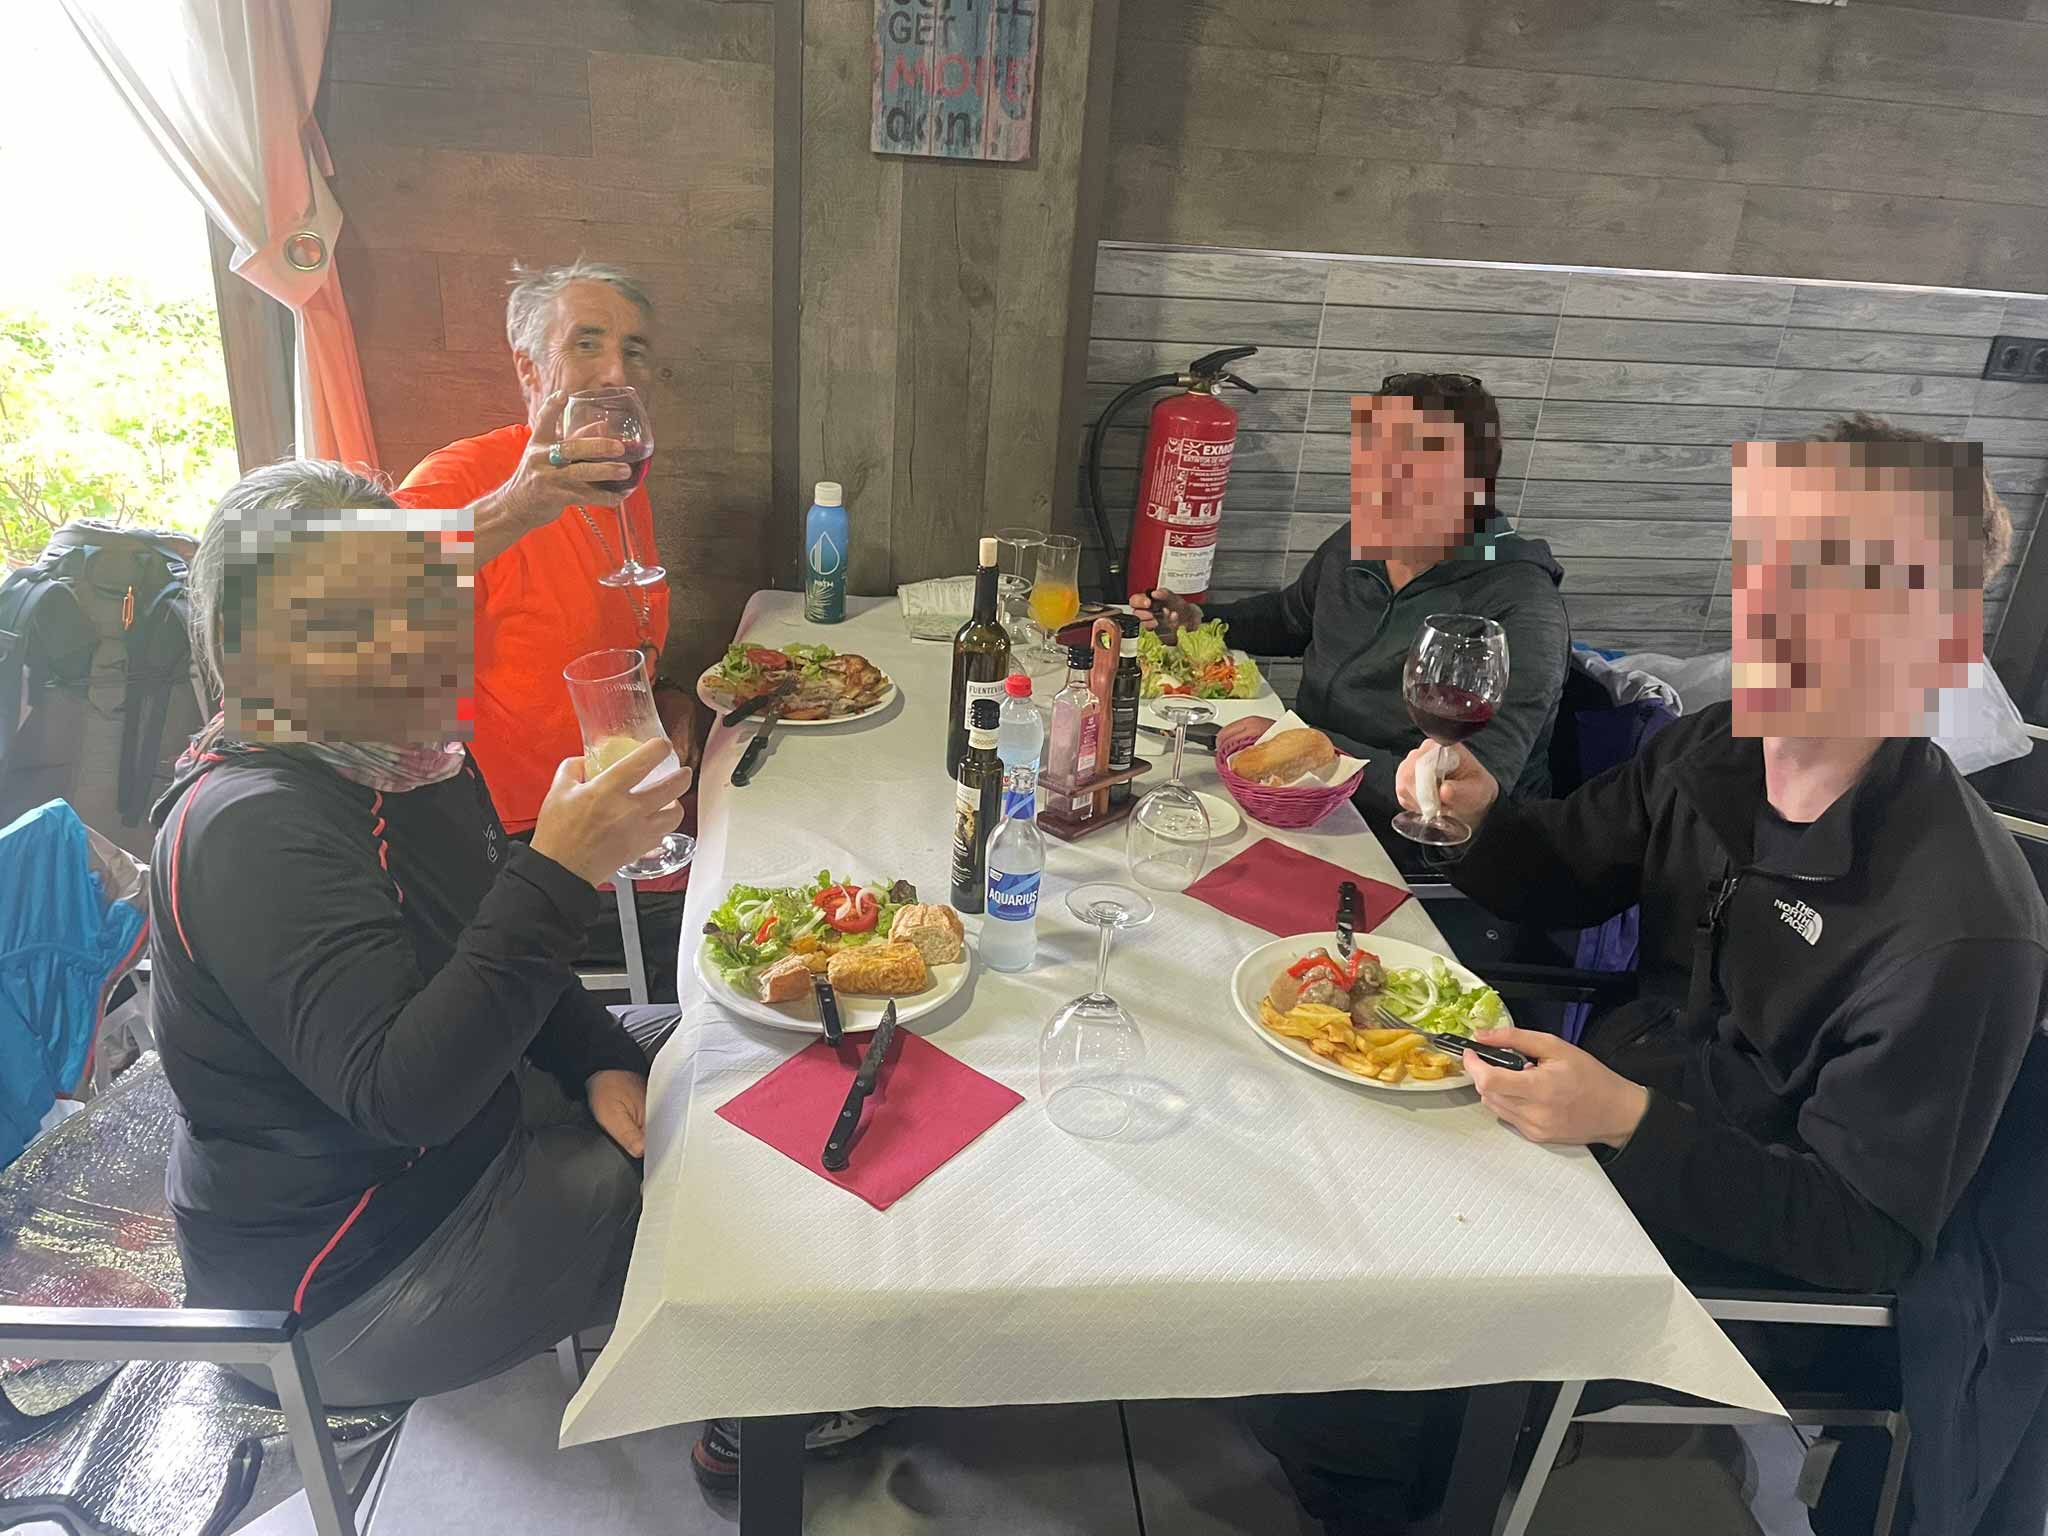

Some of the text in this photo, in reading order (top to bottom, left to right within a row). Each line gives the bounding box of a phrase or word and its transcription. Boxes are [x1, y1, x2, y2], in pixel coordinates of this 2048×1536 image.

[888, 11, 956, 47] GET
[988, 887, 1038, 906] AQUARIUS
[1773, 899, 1810, 926] NORTH
[1795, 900, 1816, 918] THE
[1780, 912, 1806, 934] FACE
[709, 1441, 738, 1457] SALO
